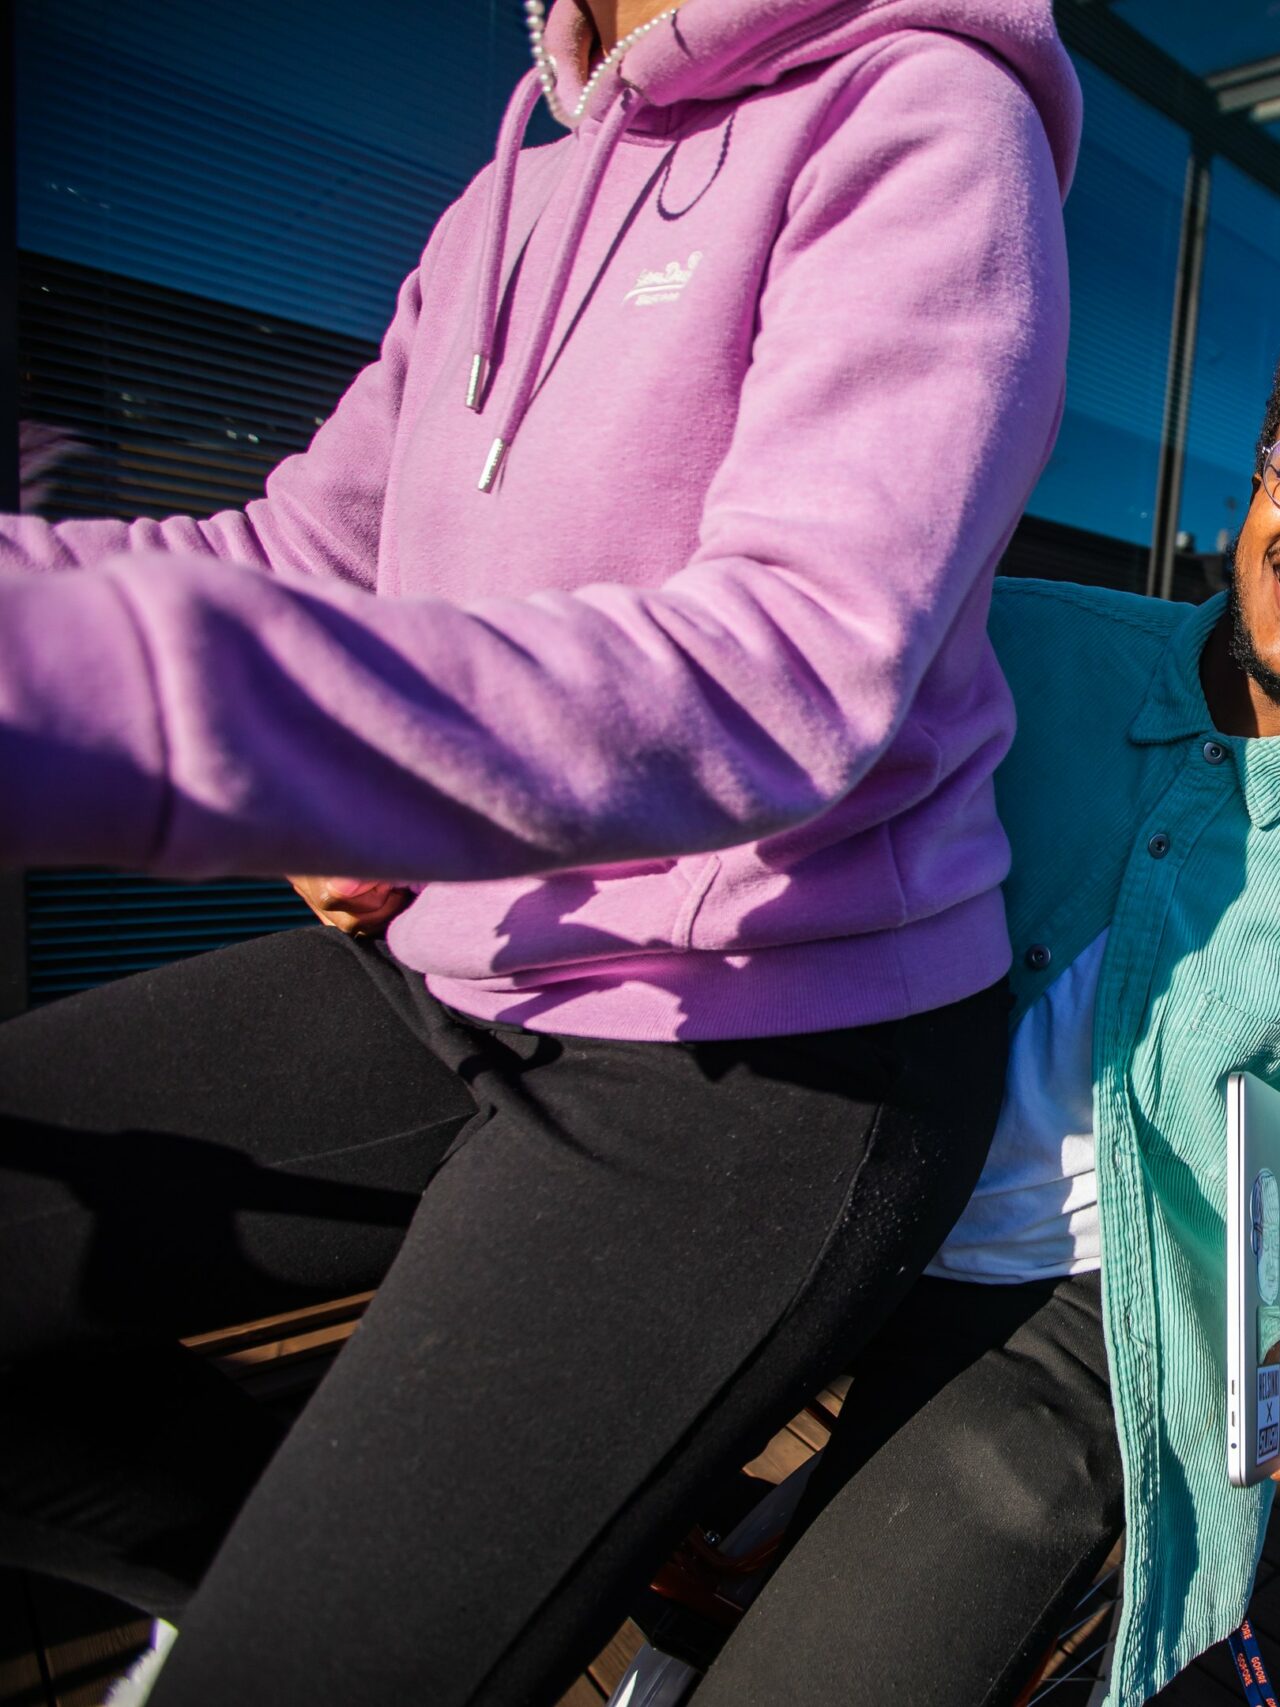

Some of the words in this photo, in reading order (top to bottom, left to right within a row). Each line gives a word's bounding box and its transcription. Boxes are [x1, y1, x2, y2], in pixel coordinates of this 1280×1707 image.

[1241, 1620, 1253, 1640] ORE
[1238, 1652, 1253, 1687] GOFORE
[1251, 1656, 1267, 1684] GOFORE
